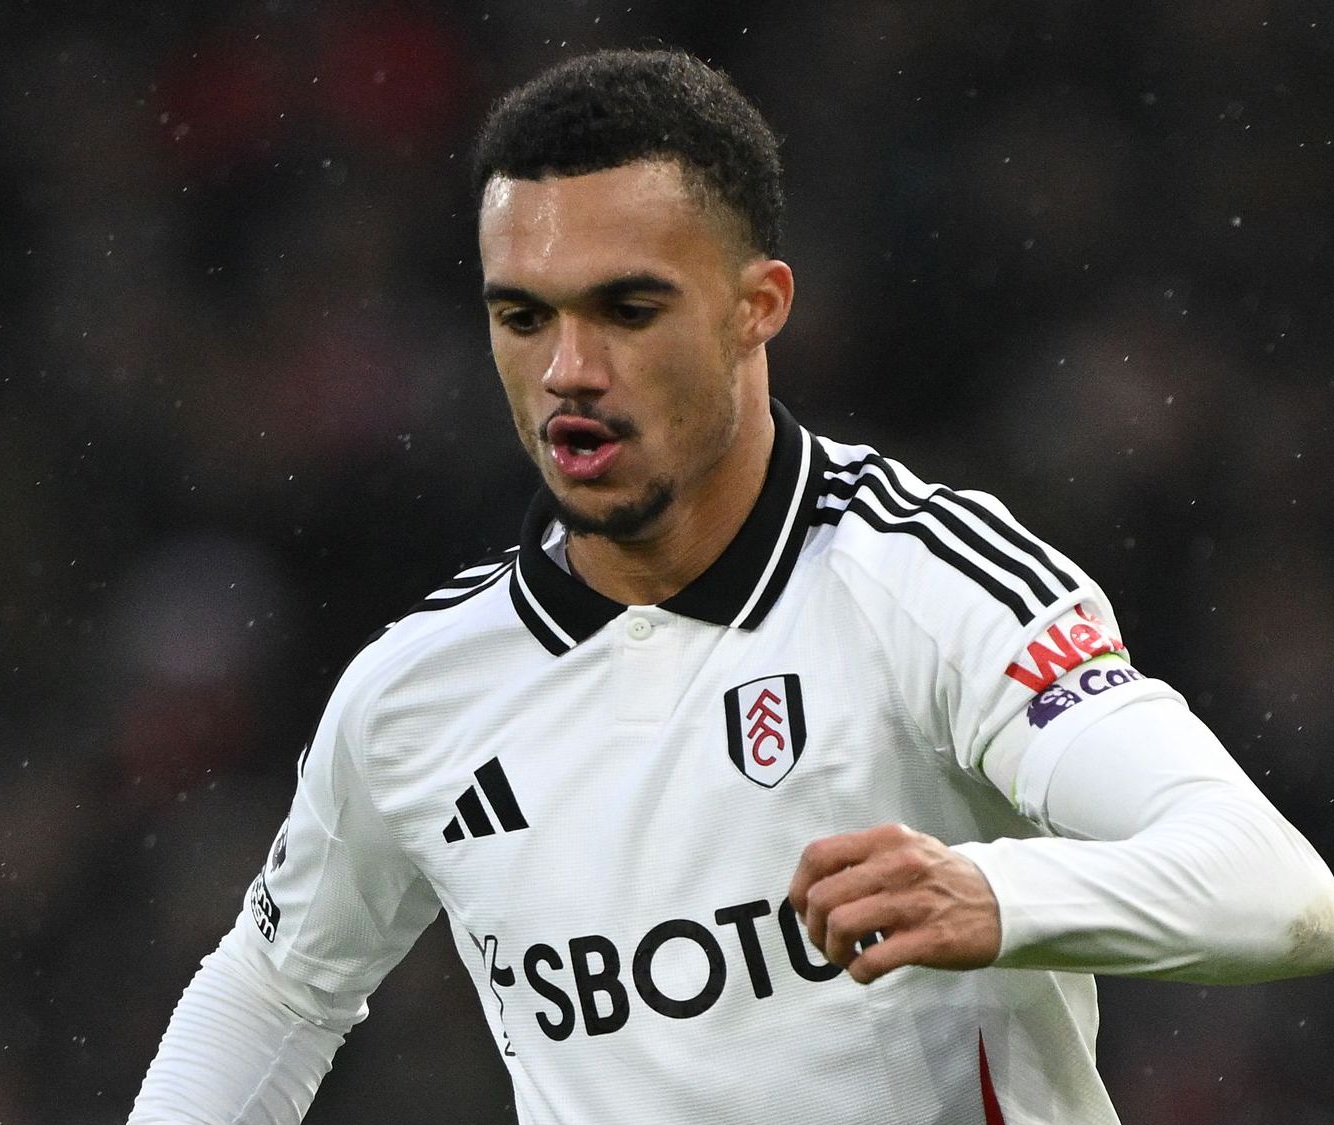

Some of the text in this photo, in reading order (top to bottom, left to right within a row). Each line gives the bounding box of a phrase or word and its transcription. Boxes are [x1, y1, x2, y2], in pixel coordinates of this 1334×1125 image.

[1004, 603, 1125, 693] We
[746, 688, 785, 767] FFC
[523, 896, 881, 1042] SBOT
